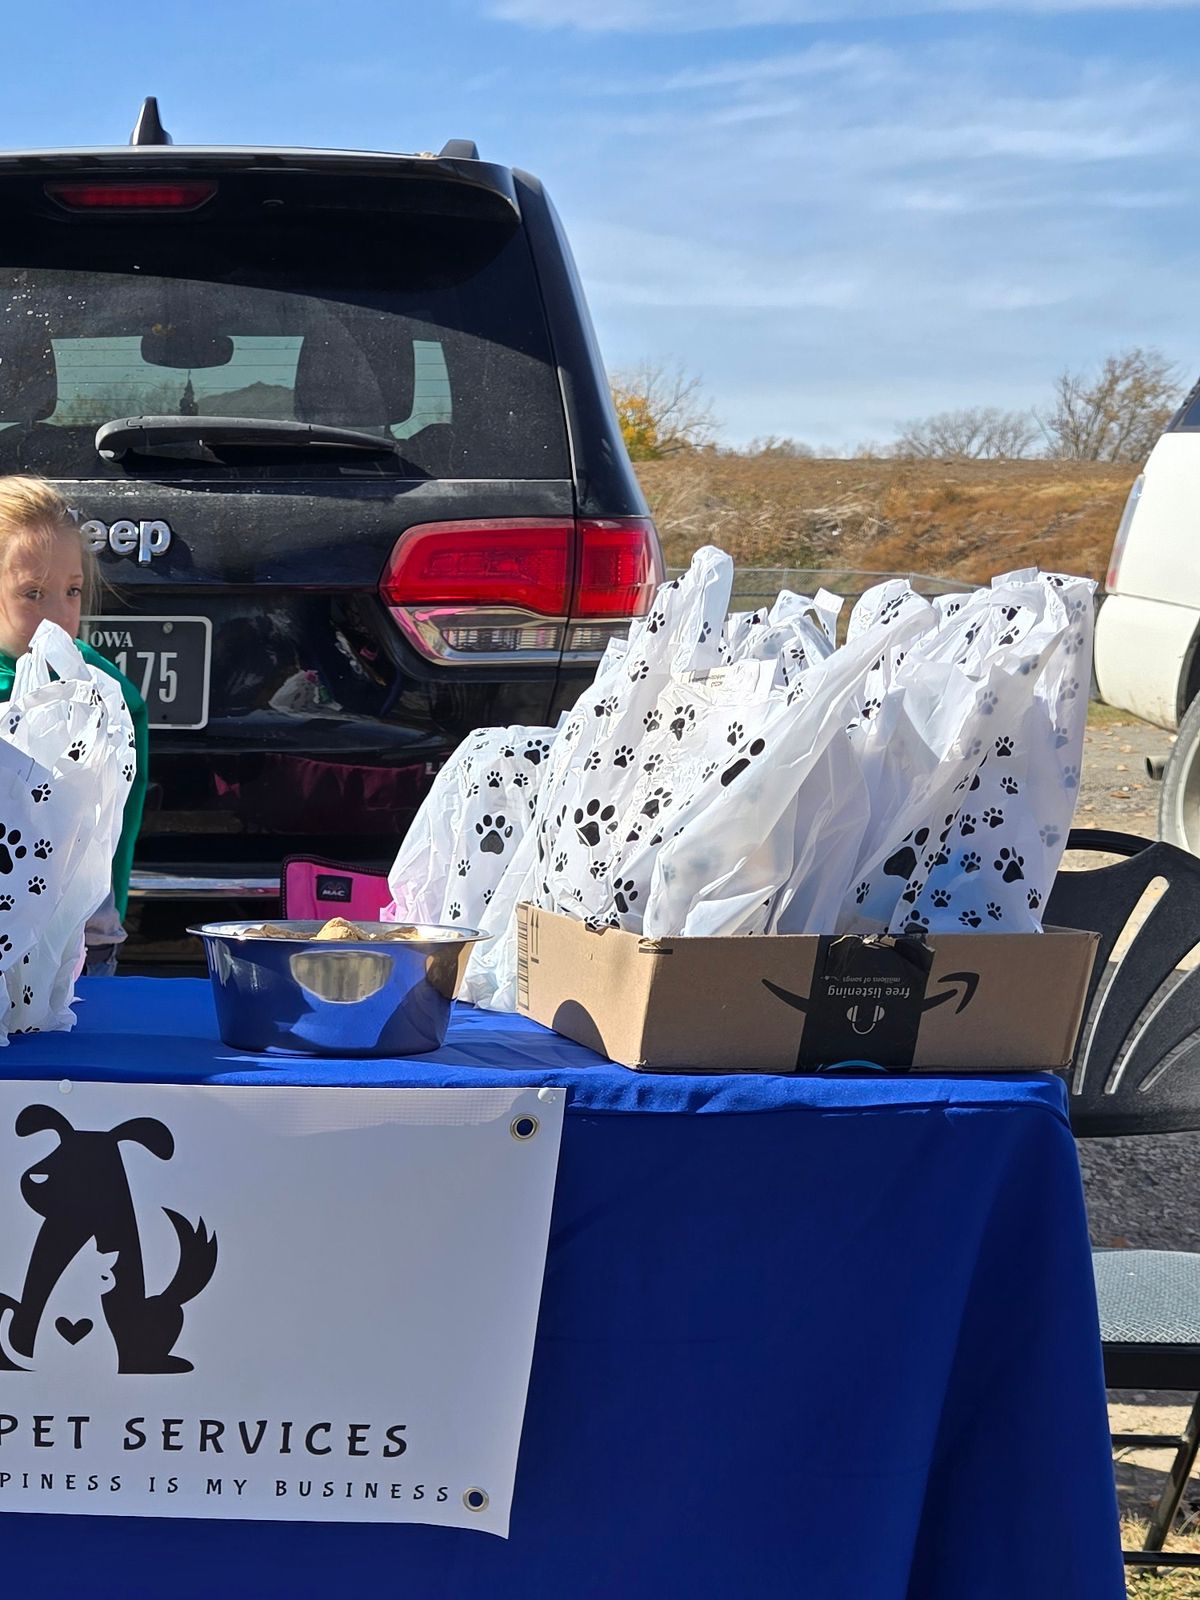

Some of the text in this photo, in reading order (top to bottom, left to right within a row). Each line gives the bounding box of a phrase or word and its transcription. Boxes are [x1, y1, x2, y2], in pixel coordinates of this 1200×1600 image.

[65, 507, 171, 563] eep
[827, 984, 910, 999] free listening
[123, 1417, 408, 1458] SERVICES
[149, 1476, 179, 1494] IS
[206, 1478, 248, 1496] MY
[275, 1480, 449, 1503] BUSINESS
